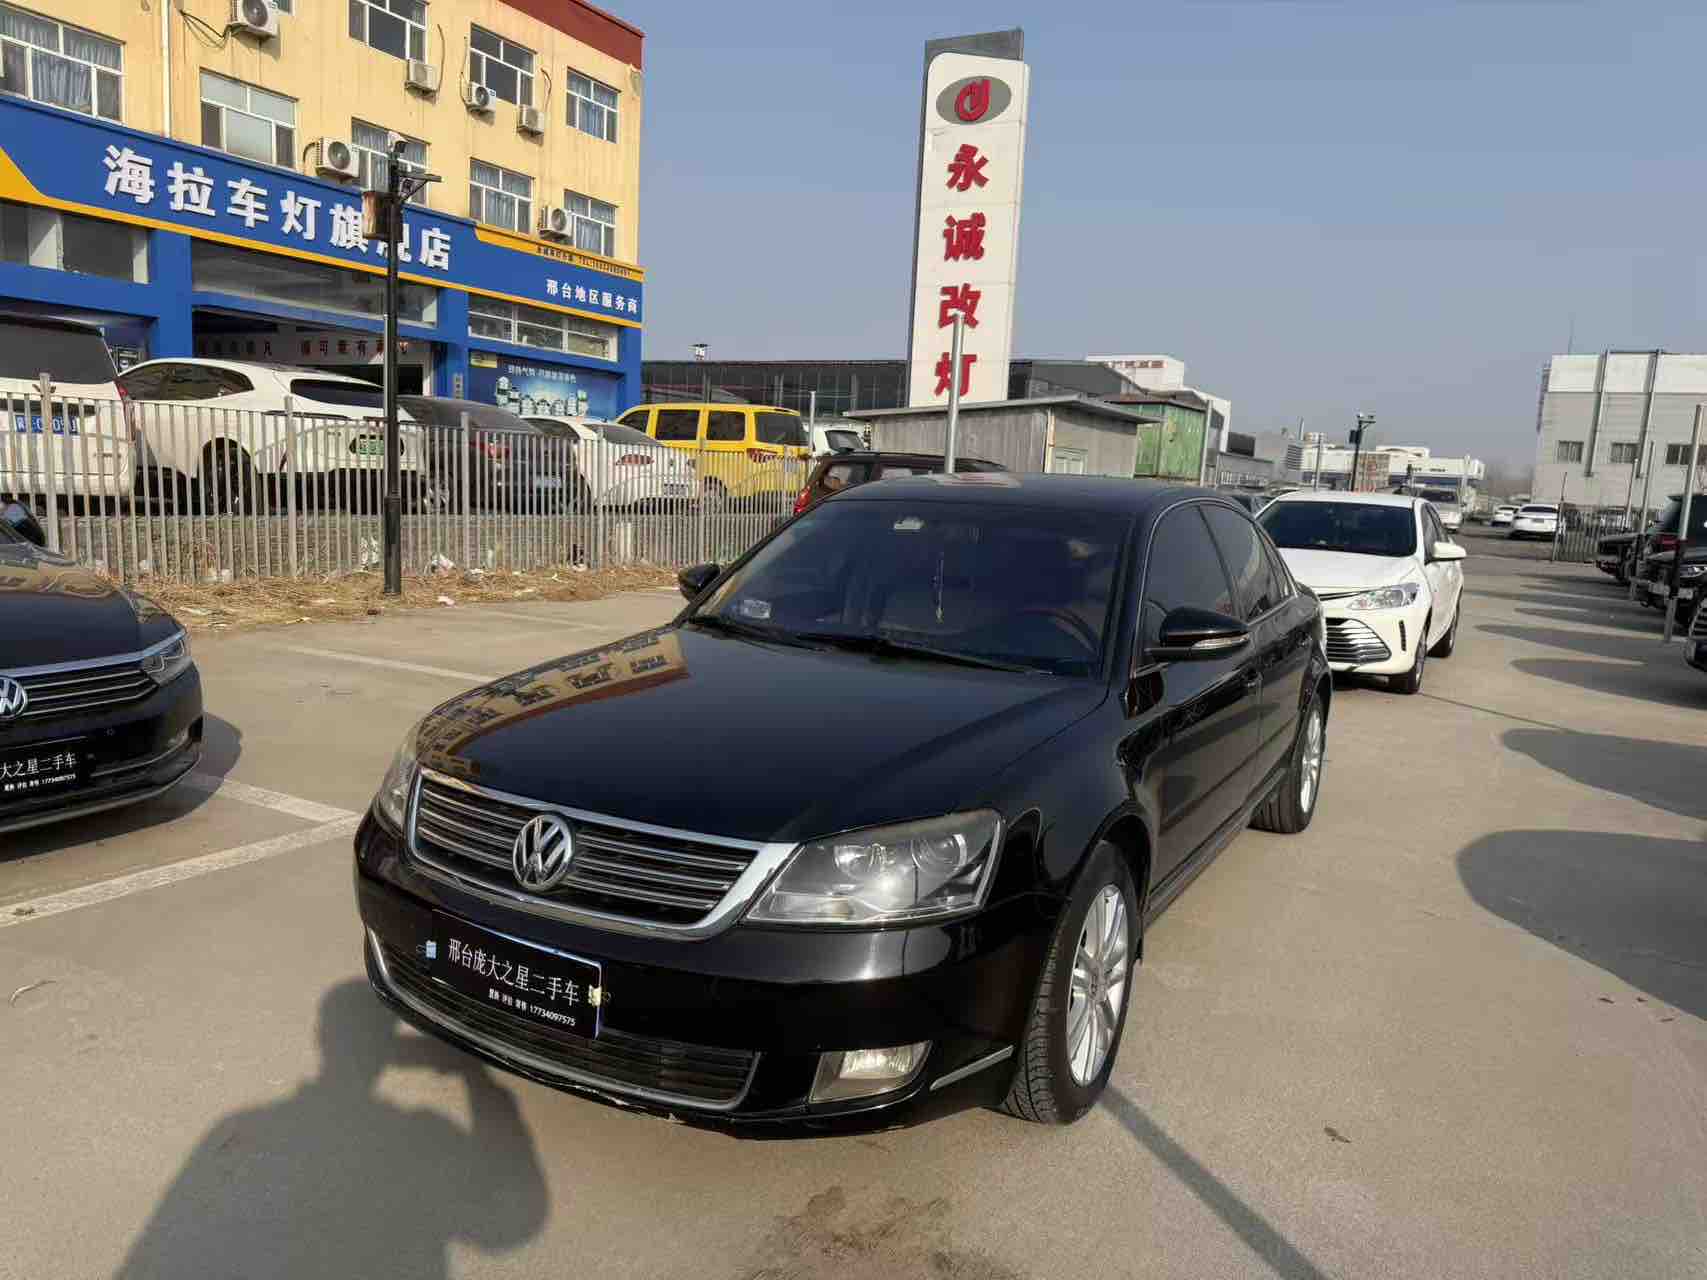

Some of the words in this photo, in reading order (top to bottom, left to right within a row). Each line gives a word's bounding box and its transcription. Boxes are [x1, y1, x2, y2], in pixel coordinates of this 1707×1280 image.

[546, 279, 638, 314] 邢台地区服务商
[933, 143, 989, 397] 永诚改灯
[448, 937, 580, 1006] 邢台庞大之星二手车
